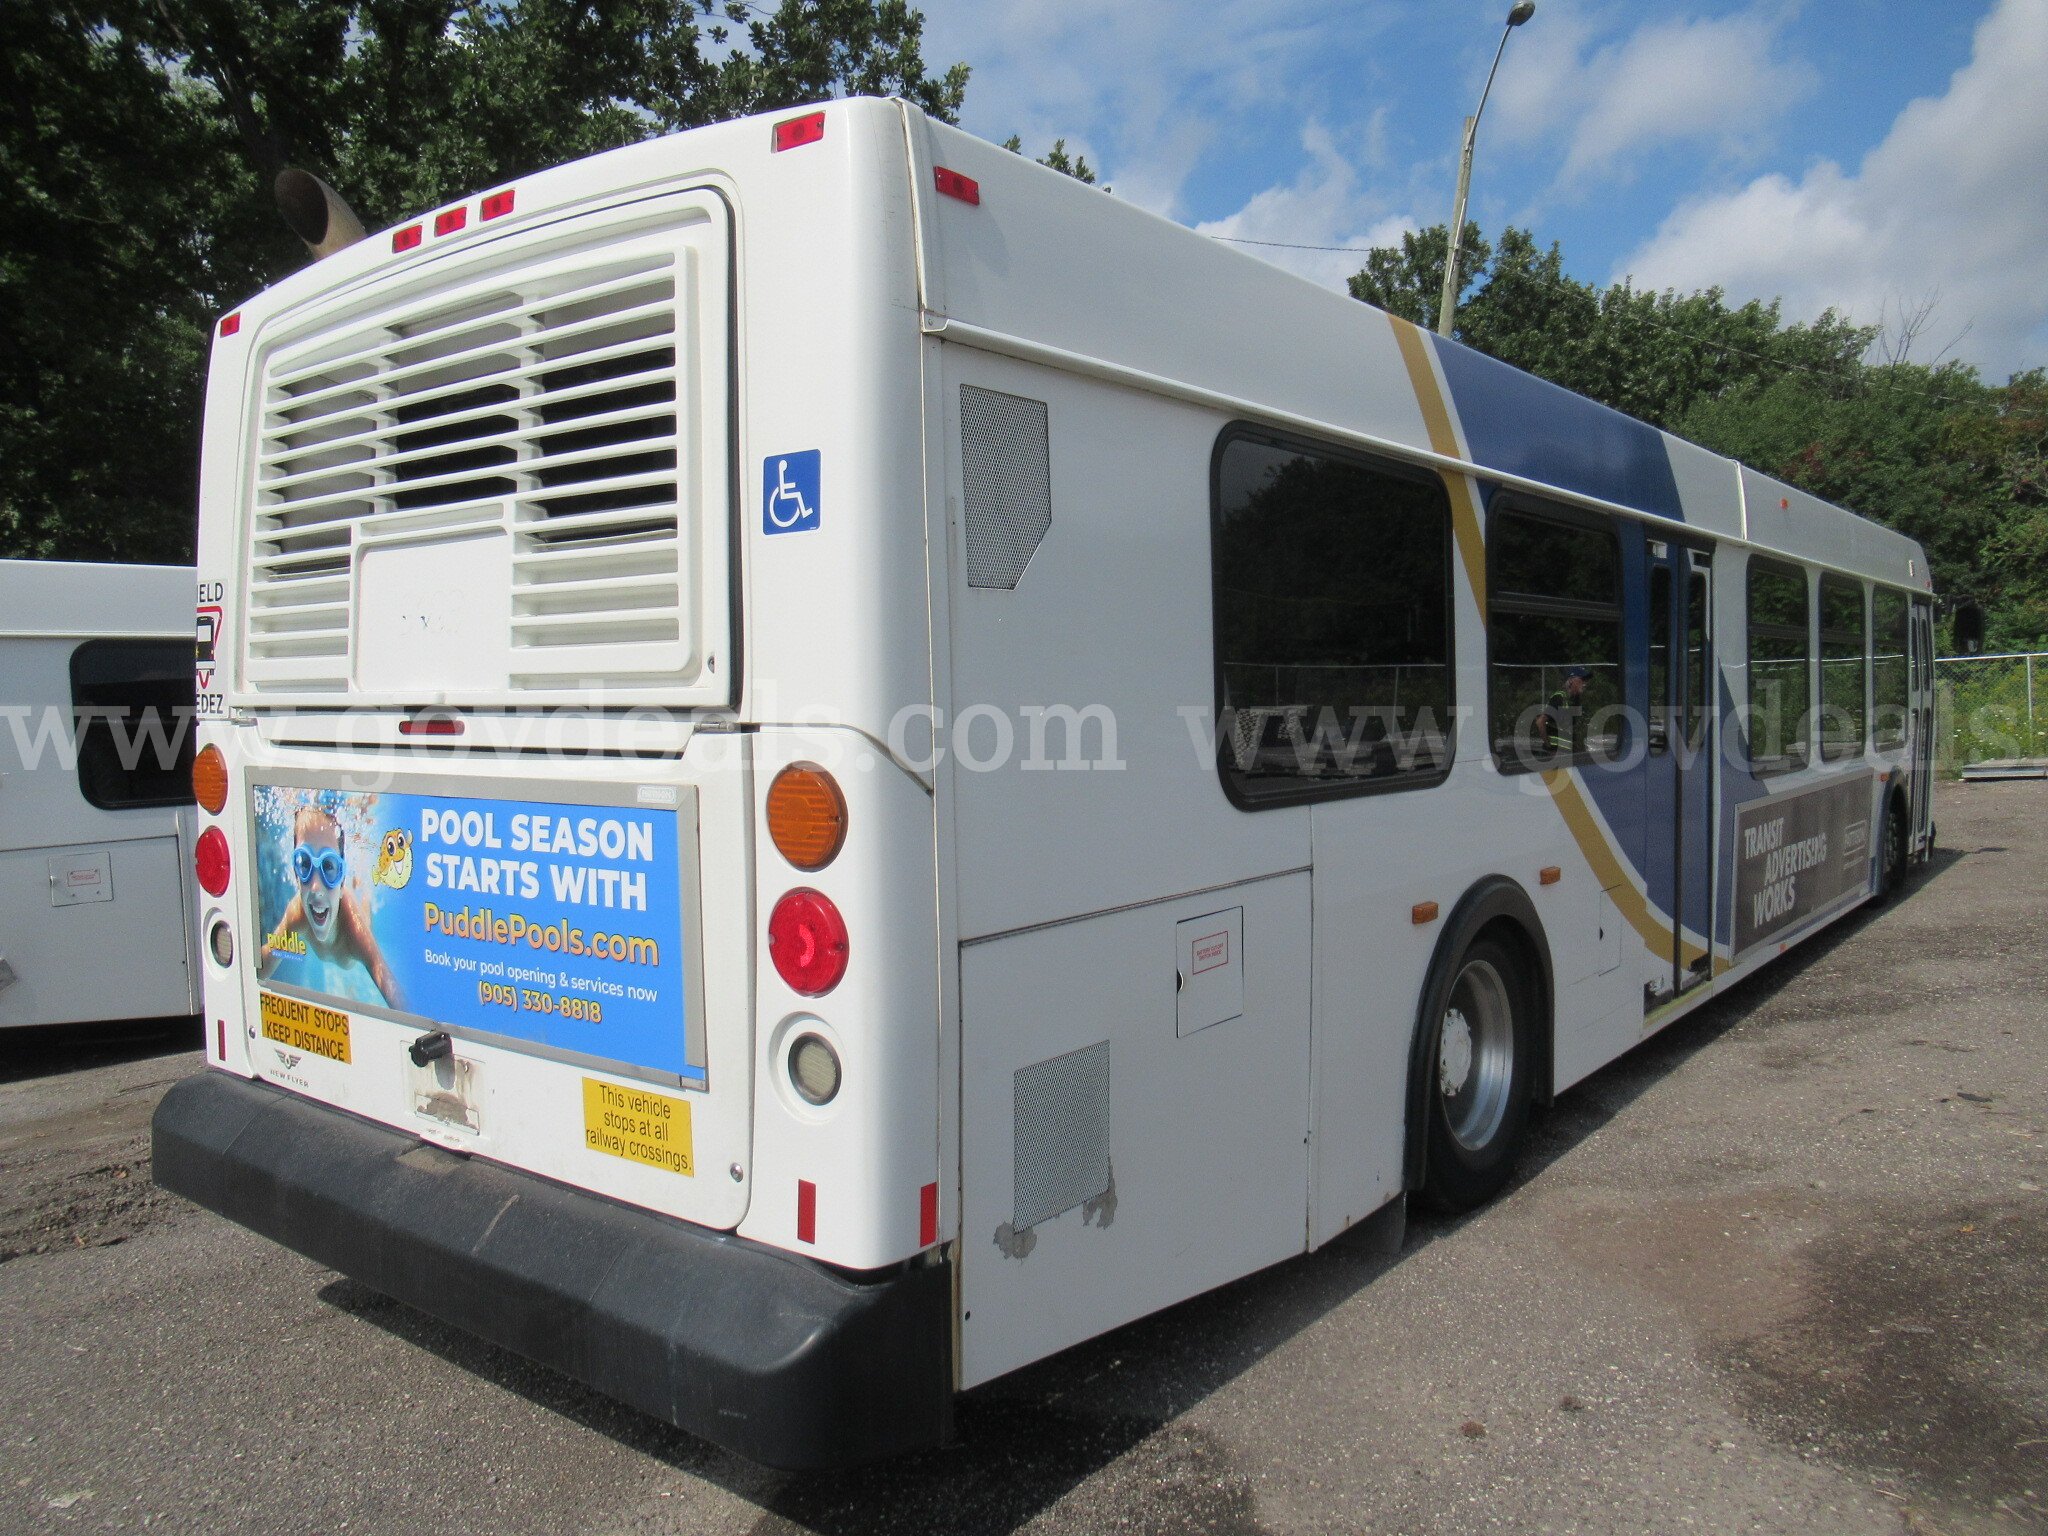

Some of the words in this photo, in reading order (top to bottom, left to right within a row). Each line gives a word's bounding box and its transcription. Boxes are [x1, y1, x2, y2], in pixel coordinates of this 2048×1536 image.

[421, 808, 502, 849] POOL
[510, 814, 653, 861] SEASON
[1744, 817, 1784, 860] TRANSIT
[426, 852, 540, 899] STARTS
[550, 864, 647, 911] WITH
[1764, 832, 1827, 886] ADVERTISING
[1753, 875, 1795, 929] WORKS
[424, 901, 660, 966] PuddlePools.com
[425, 949, 451, 966] Book
[453, 957, 477, 971] your
[480, 959, 504, 976] pool
[507, 966, 556, 989] opening
[559, 972, 569, 987] &
[571, 977, 624, 997] services
[628, 987, 658, 1002] now
[260, 993, 309, 1024] FREQUENT
[313, 1008, 349, 1036] STOPS
[478, 979, 518, 1012] (905)
[522, 988, 603, 1023] 330-8818
[266, 1020, 291, 1043] KEEP
[294, 1029, 344, 1061] DISTANCE
[599, 1084, 624, 1108] This
[628, 1094, 671, 1119] vehicle
[604, 1110, 636, 1134] stops
[640, 1119, 651, 1137] at
[655, 1122, 669, 1141] all
[586, 1127, 626, 1156] railway
[630, 1140, 692, 1172] crossings.
